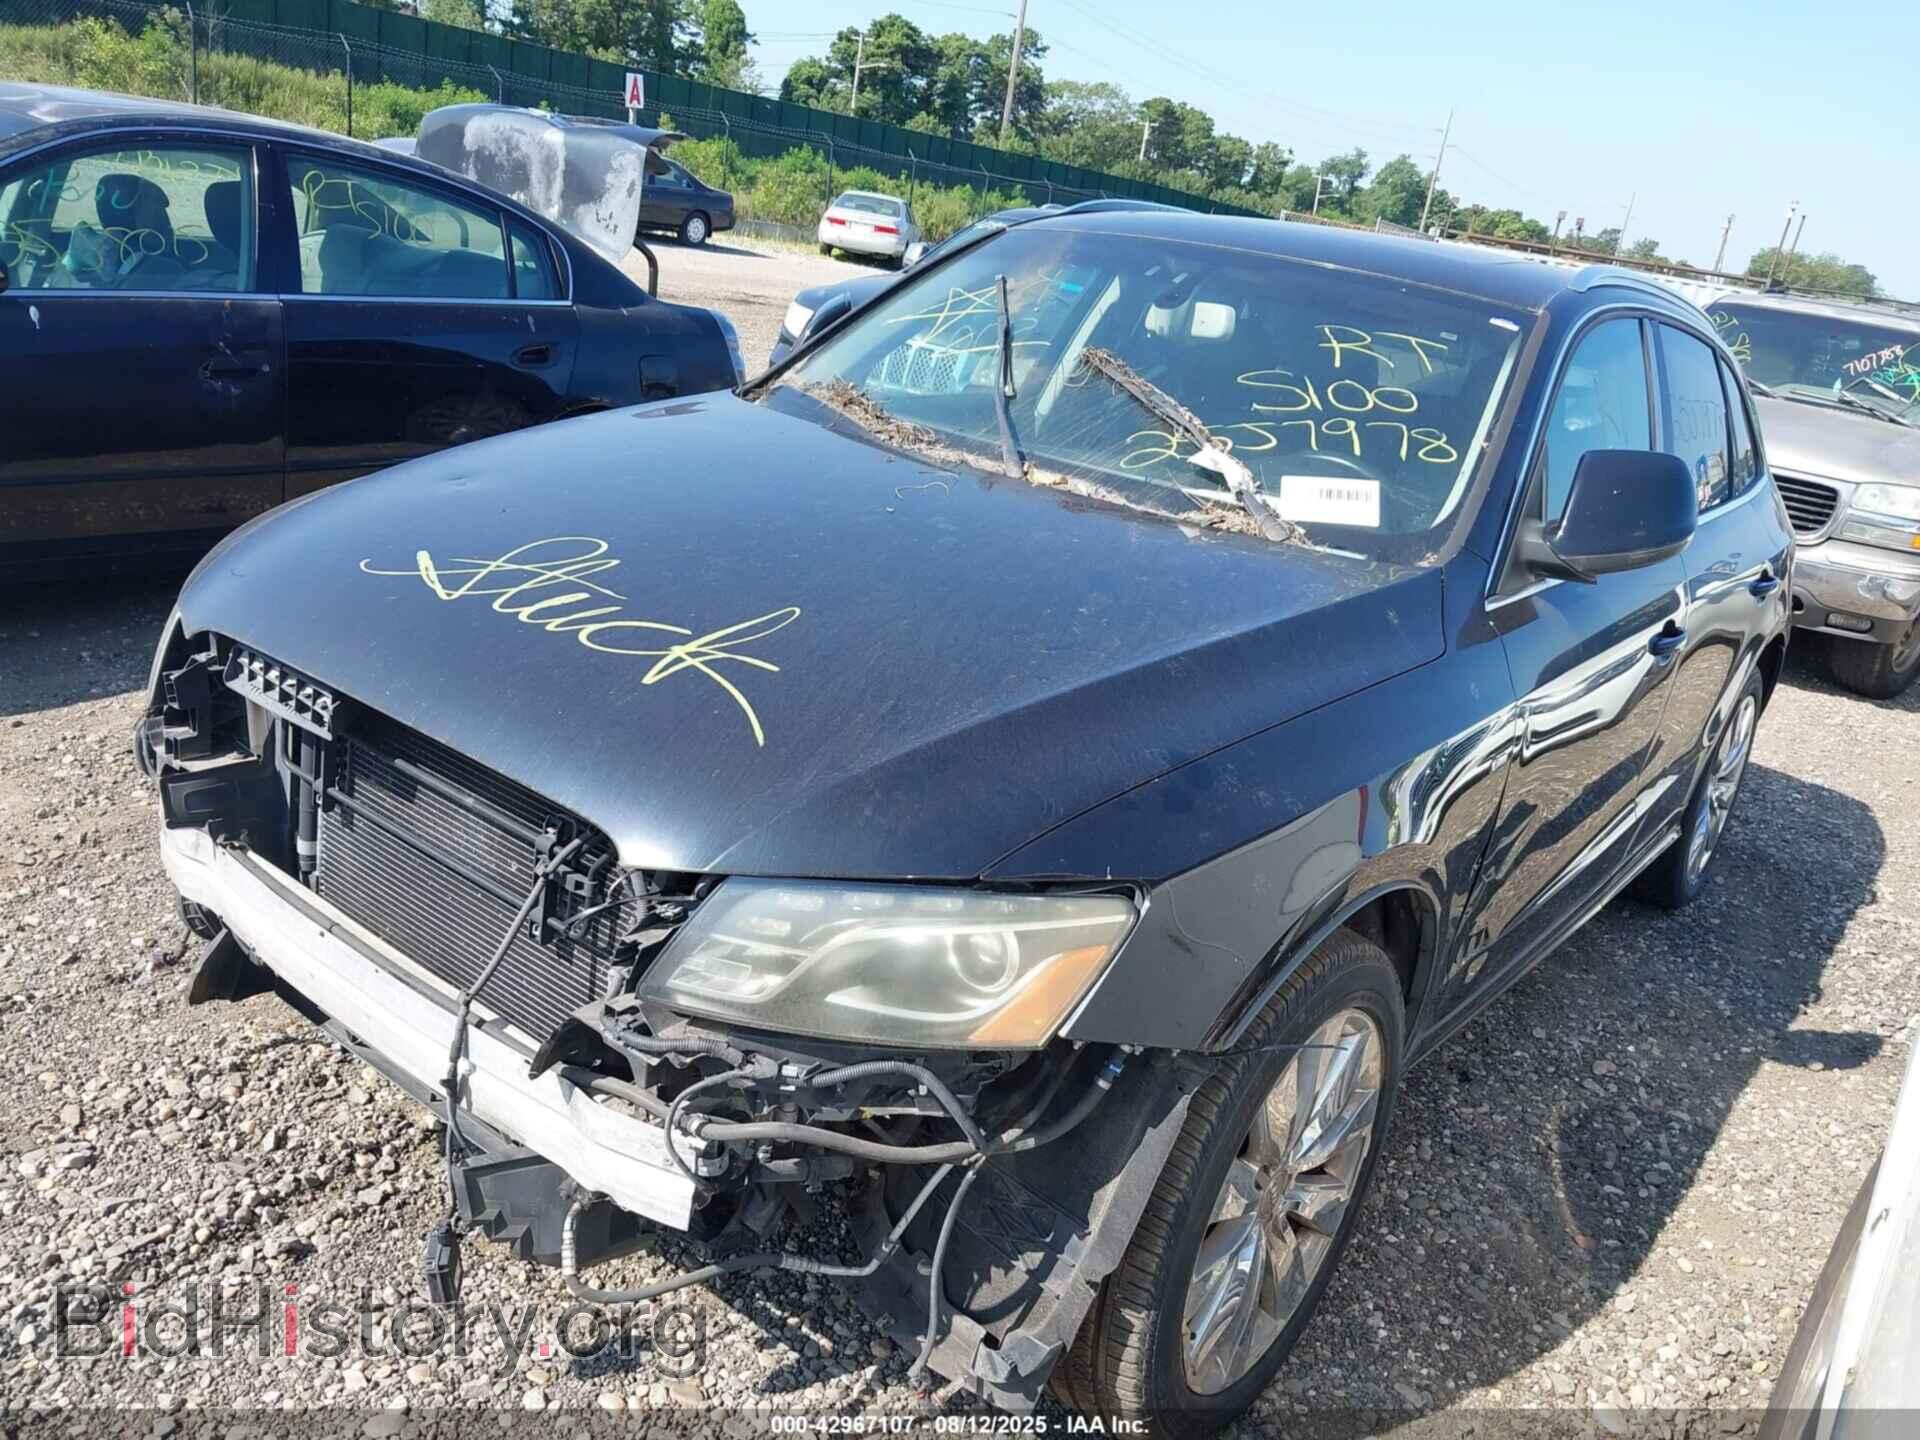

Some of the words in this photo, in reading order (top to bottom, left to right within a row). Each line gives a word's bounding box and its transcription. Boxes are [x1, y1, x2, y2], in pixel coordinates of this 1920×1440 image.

[629, 76, 641, 105] A
[1314, 324, 1448, 372] RT
[1236, 369, 1418, 412] S100
